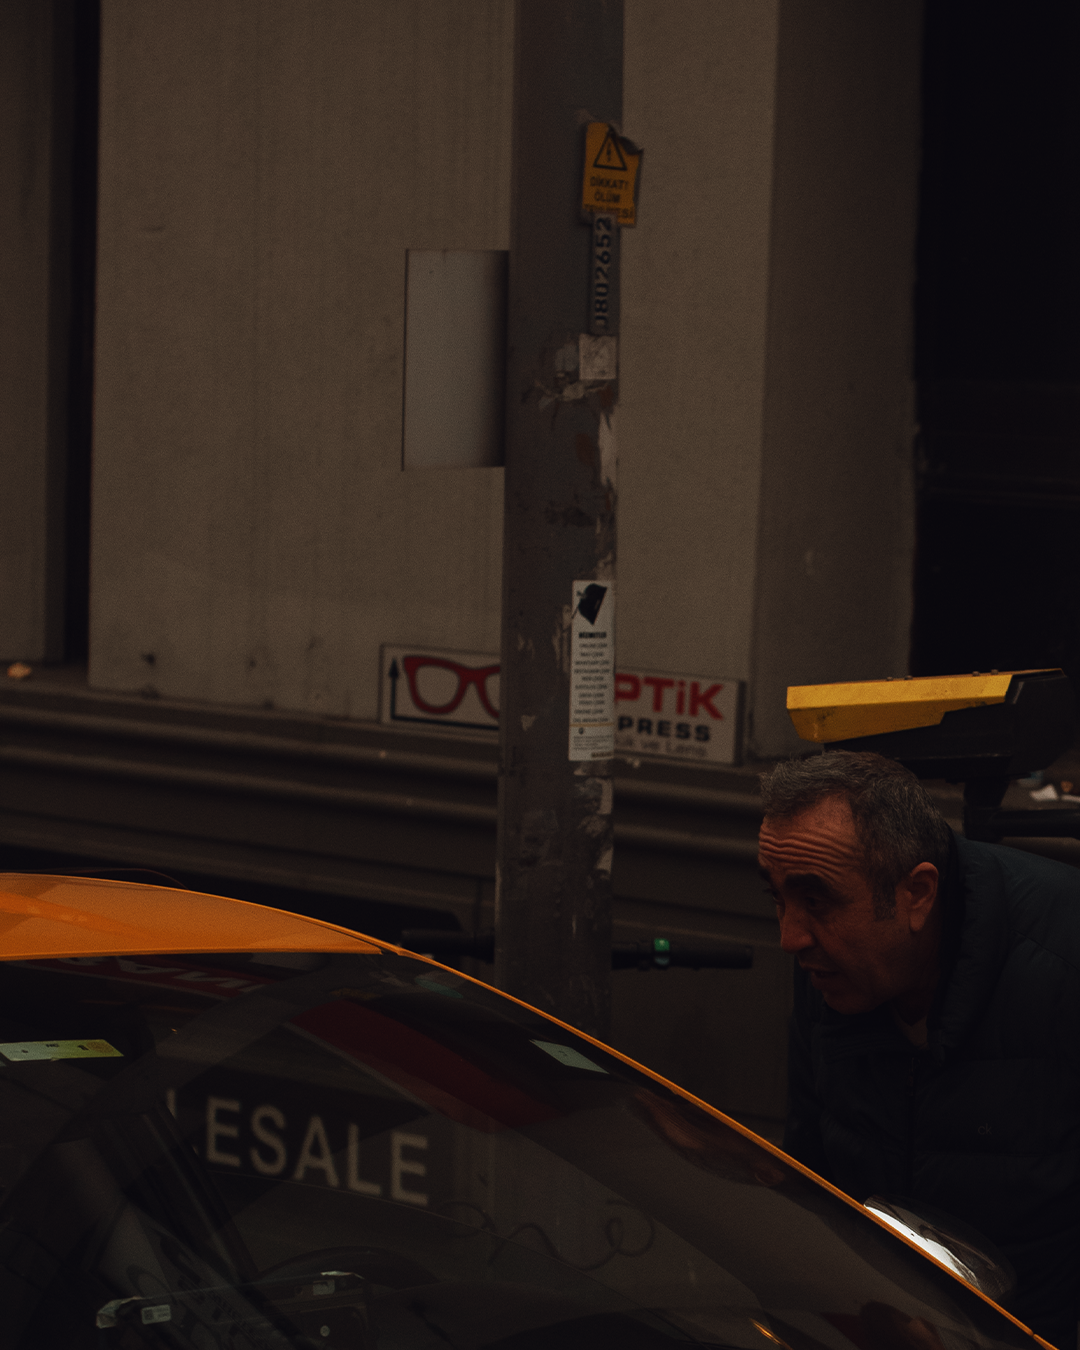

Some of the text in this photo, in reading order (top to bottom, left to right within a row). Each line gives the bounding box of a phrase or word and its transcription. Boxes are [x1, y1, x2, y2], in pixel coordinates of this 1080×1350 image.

[615, 674, 724, 719] PTiK
[619, 716, 710, 742] PRESS
[977, 1122, 993, 1136] ck
